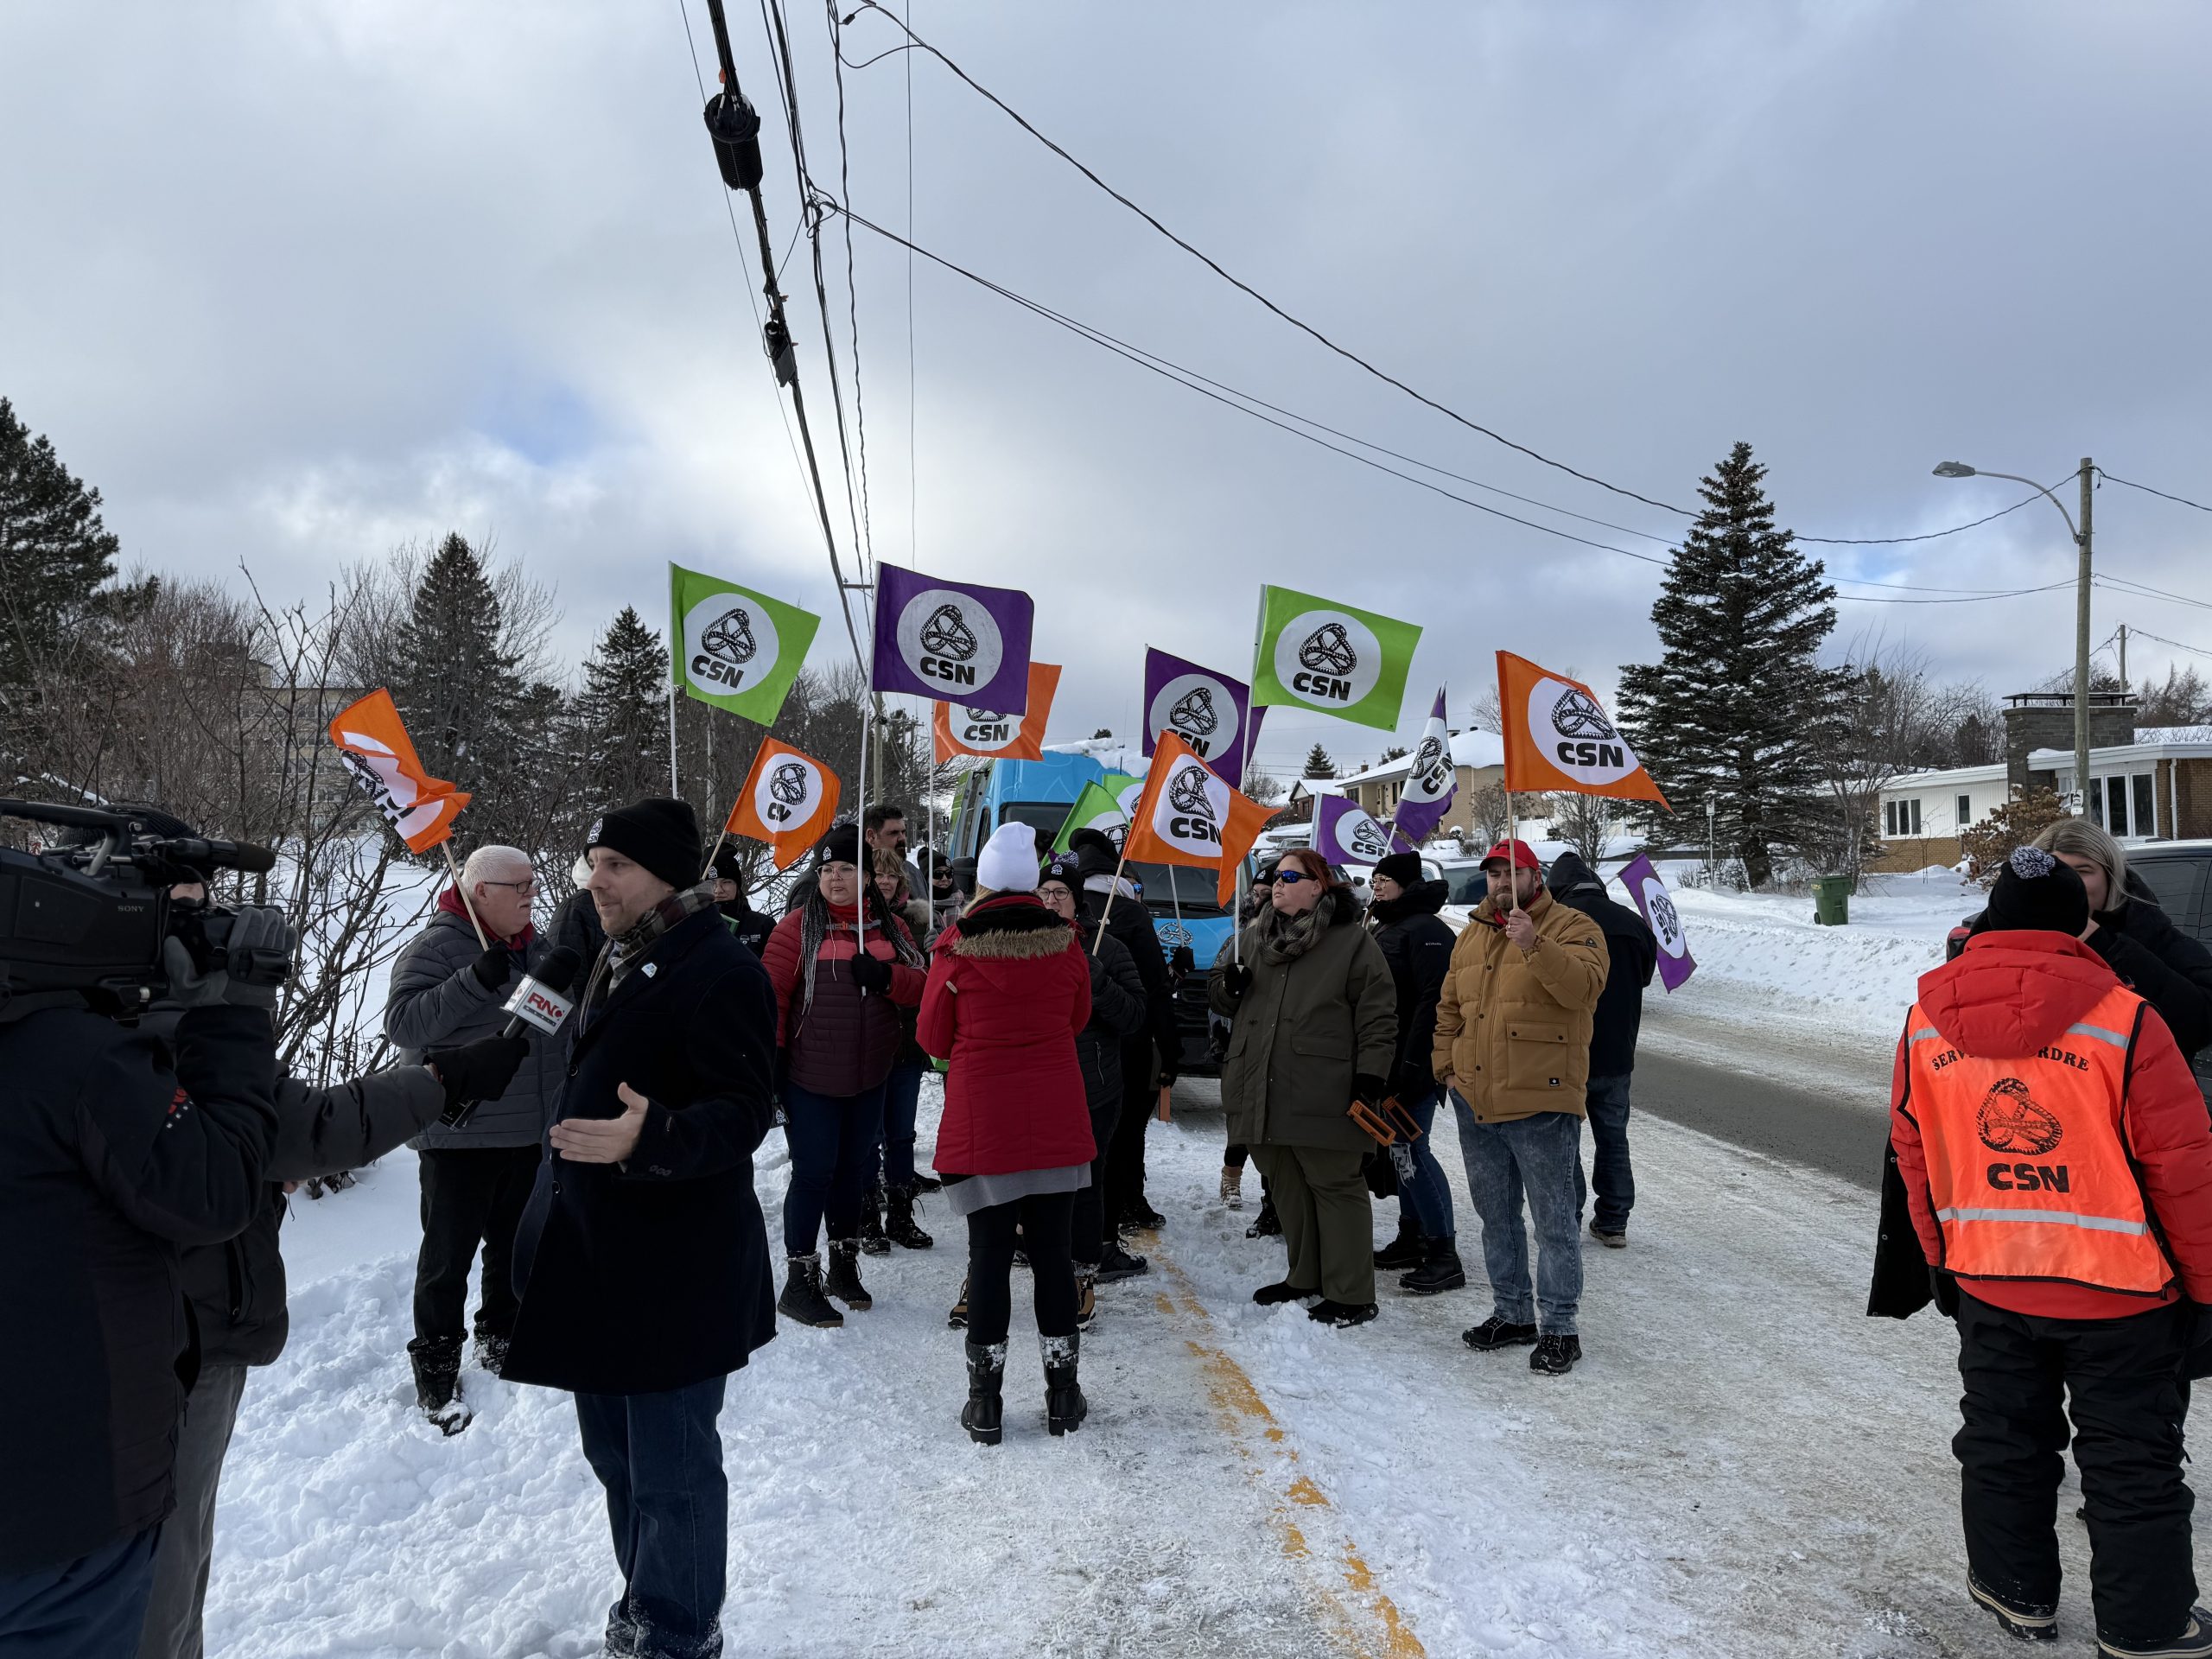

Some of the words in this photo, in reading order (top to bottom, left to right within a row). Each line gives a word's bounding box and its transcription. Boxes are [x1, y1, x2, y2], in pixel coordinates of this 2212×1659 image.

[691, 655, 745, 689] CSN
[920, 656, 976, 685] CSN
[1293, 672, 1351, 701] CSN
[963, 724, 1009, 742] CSN
[1557, 741, 1624, 767] CSN
[1650, 899, 1672, 946] CSN
[1931, 1048, 1974, 1071] SERV
[2037, 1046, 2089, 1071] RDRE
[1986, 1163, 2069, 1193] CSN
